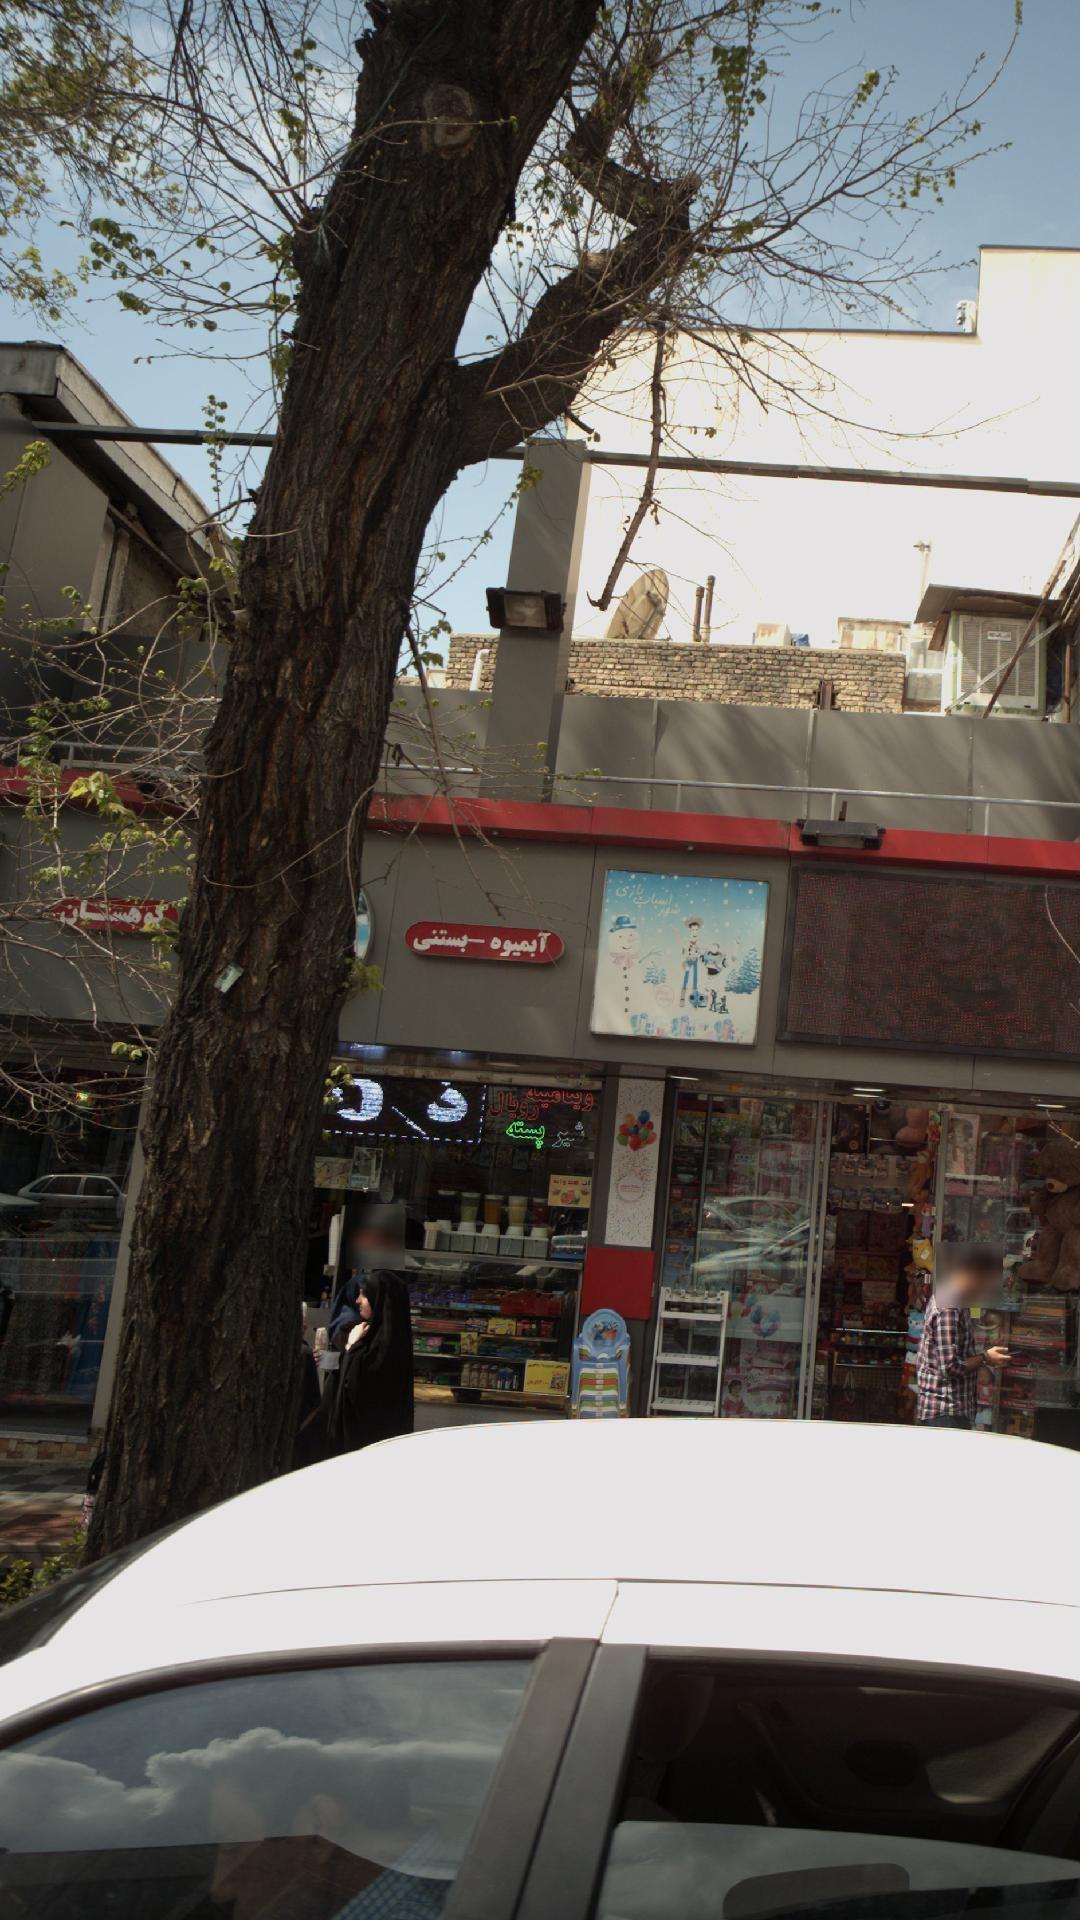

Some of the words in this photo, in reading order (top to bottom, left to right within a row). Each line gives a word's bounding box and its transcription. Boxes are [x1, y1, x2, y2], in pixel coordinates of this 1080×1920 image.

[490, 931, 551, 957] آبمیوه
[487, 1089, 540, 1120] رویال
[505, 1121, 545, 1149] پسته
